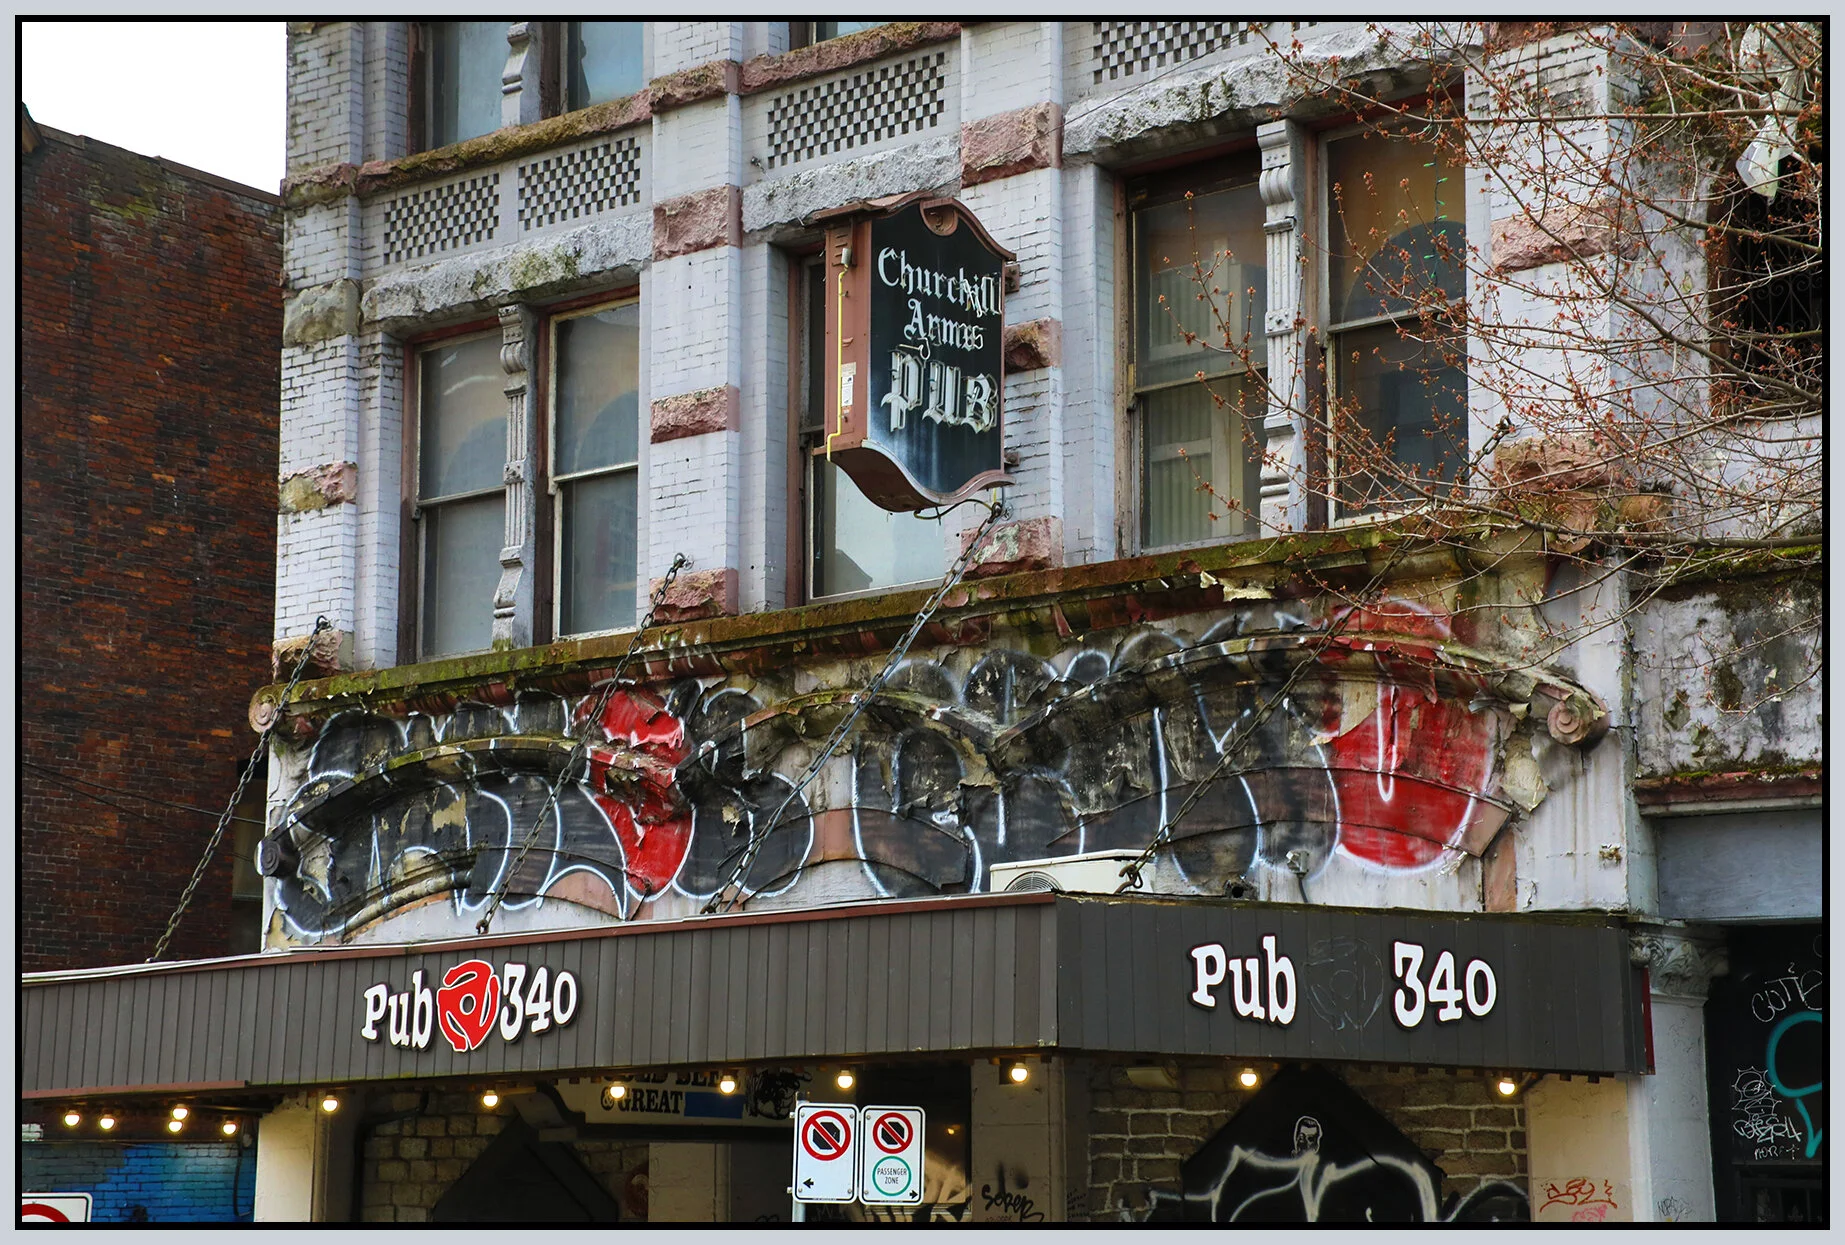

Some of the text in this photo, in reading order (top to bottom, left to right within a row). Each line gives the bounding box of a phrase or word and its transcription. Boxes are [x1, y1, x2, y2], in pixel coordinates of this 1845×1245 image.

[877, 246, 1002, 318] Churchill
[903, 298, 984, 352] Arms
[361, 962, 577, 1049] Pub 340
[1191, 935, 1497, 1027] Pub 340
[617, 1088, 683, 1114] GREAT
[876, 1167, 907, 1176] PASSENGER
[884, 1176, 899, 1185] ZONE
